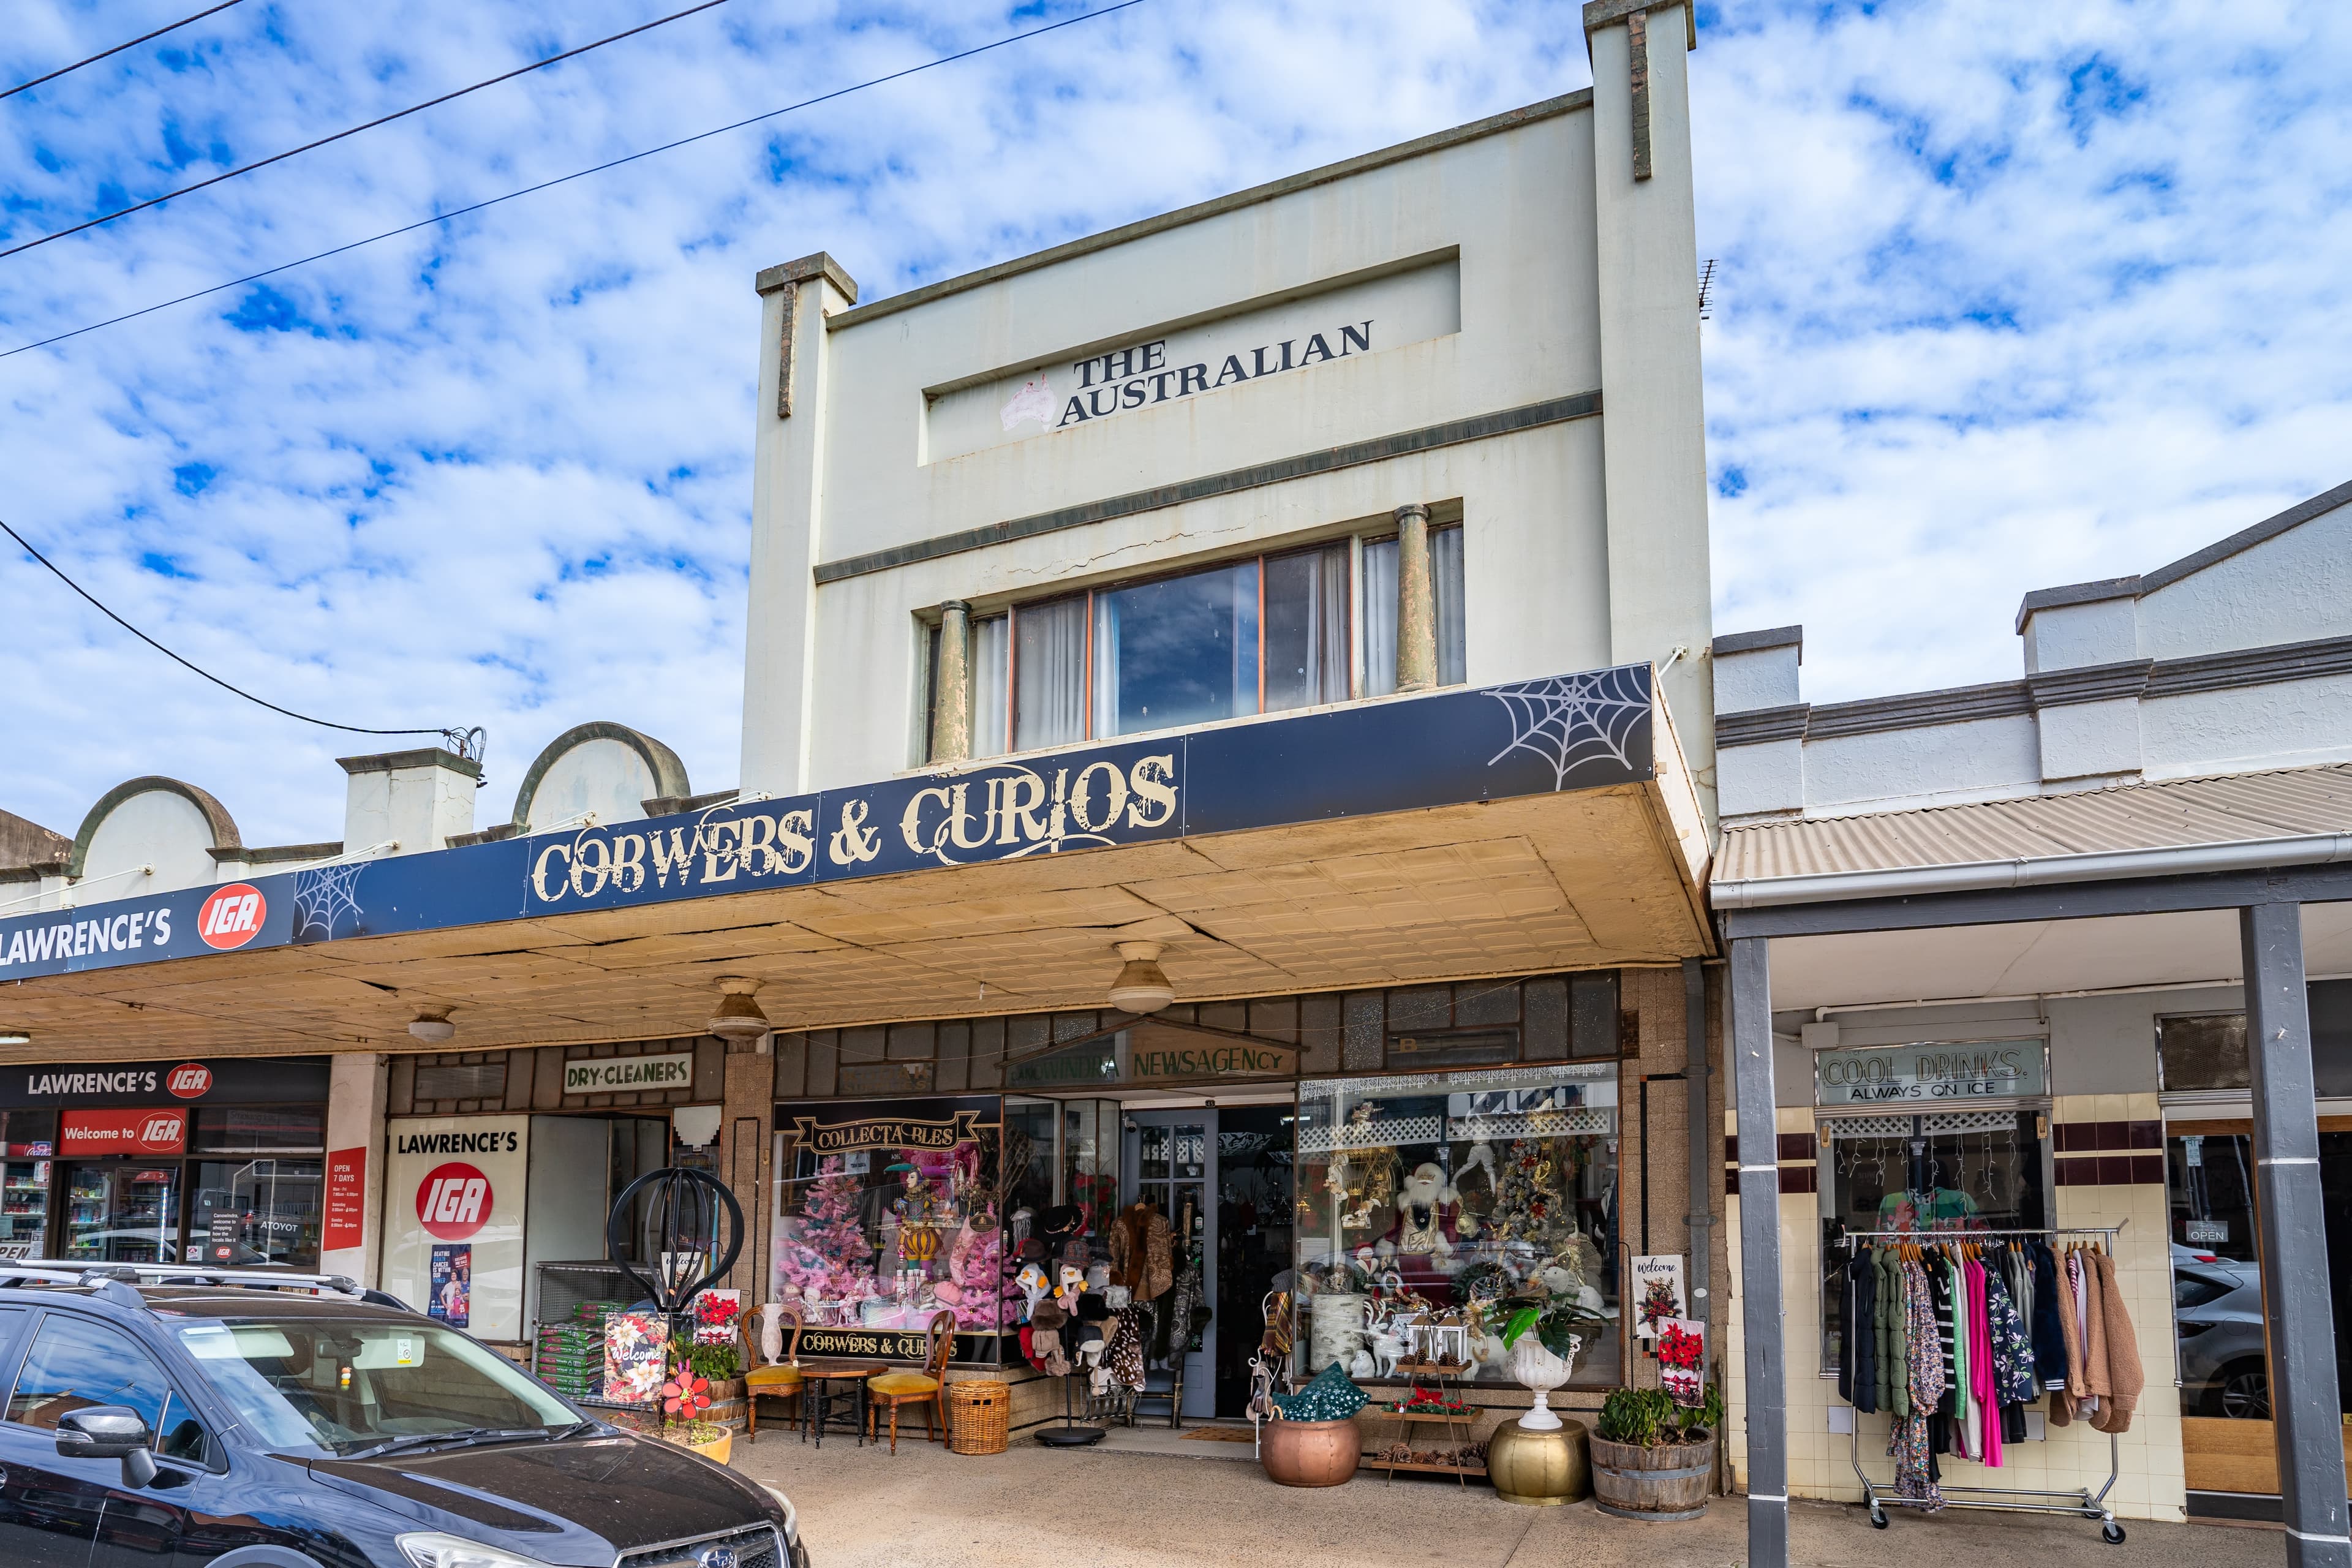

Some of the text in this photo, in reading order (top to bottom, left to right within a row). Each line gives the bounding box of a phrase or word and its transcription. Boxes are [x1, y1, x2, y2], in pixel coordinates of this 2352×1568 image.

[1056, 320, 1374, 428] AUSTRALIAN
[1074, 340, 1166, 390] THE
[531, 755, 1178, 902] COBWEBS & CURIOS
[204, 893, 259, 936] IGA
[0, 908, 172, 966] LAWRENCE'S
[1134, 1047, 1283, 1076] NEWSAGENCY
[1823, 1057, 1902, 1085] COOL
[28, 1070, 208, 1095] LAWRENCE'S IGA
[1851, 1082, 1994, 1099] ALWAYS ON ICE
[65, 1120, 181, 1141] Welcome to IGA
[398, 1131, 518, 1155] LAWRENCE'S
[421, 1177, 487, 1223] IGA
[2190, 1231, 2224, 1240] OPEN
[0, 1247, 30, 1259] PEN
[1637, 1260, 1677, 1273] welcome
[611, 1346, 661, 1363] Welcome
[881, 1338, 894, 1354] &
[897, 1332, 957, 1359] CURS
